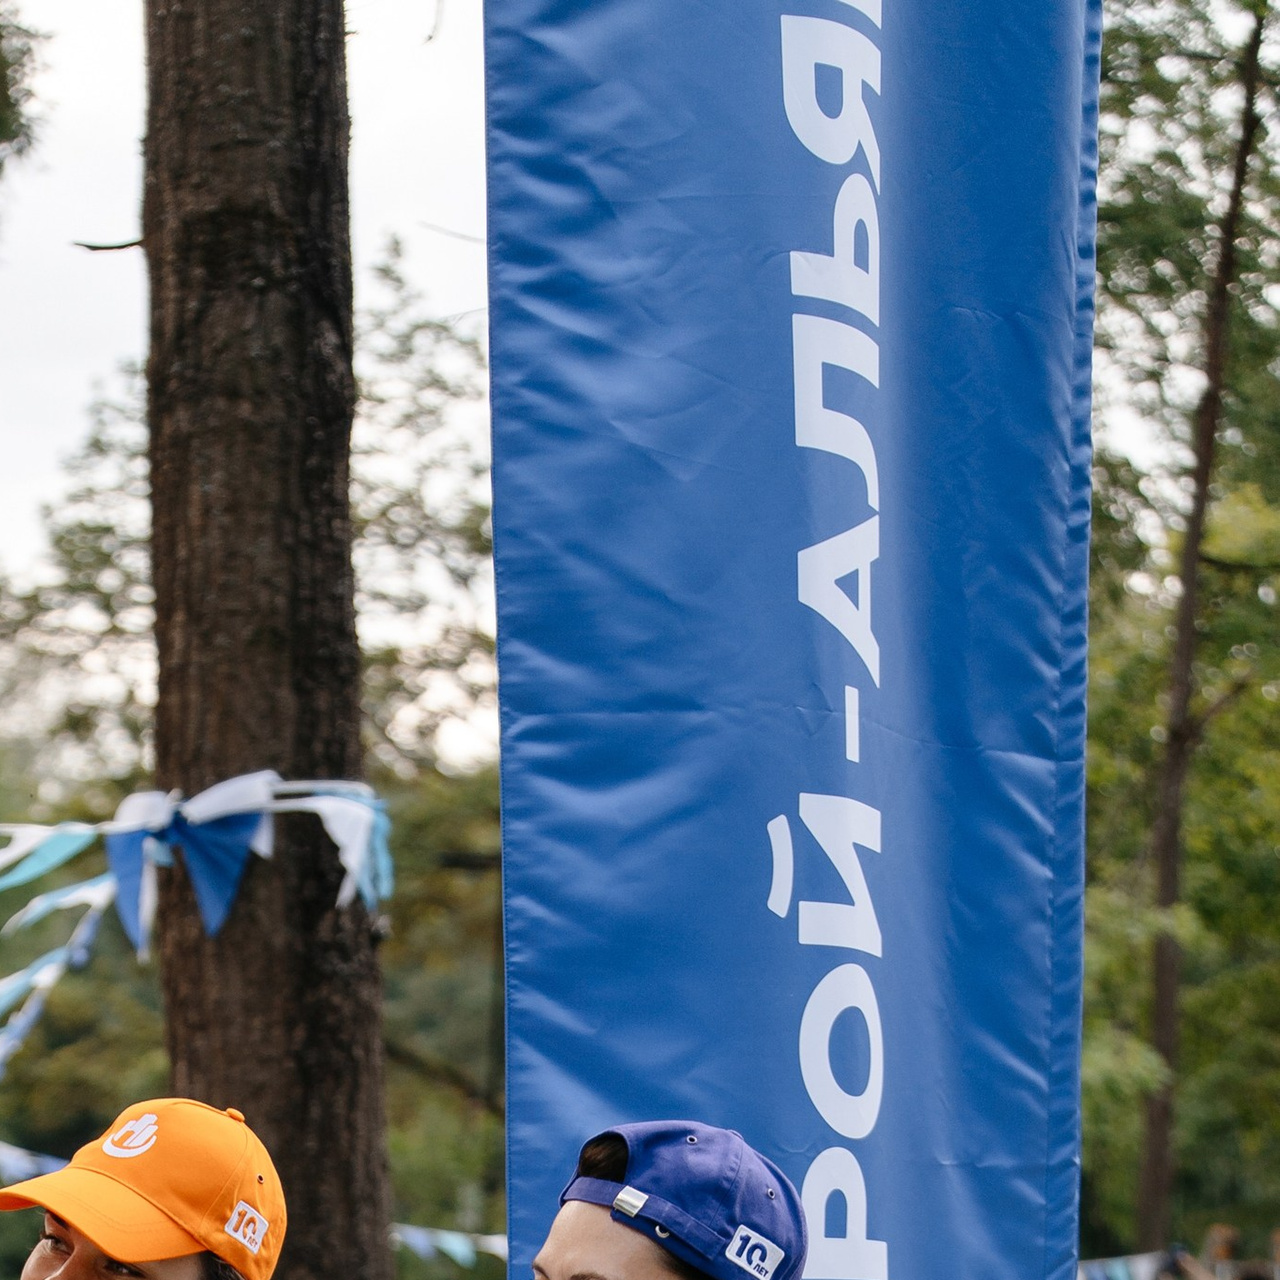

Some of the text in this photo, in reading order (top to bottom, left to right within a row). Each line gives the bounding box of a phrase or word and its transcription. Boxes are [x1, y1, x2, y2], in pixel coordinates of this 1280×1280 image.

[232, 1209, 258, 1240] 10
[735, 1234, 769, 1277] 10 ЛЕТ
